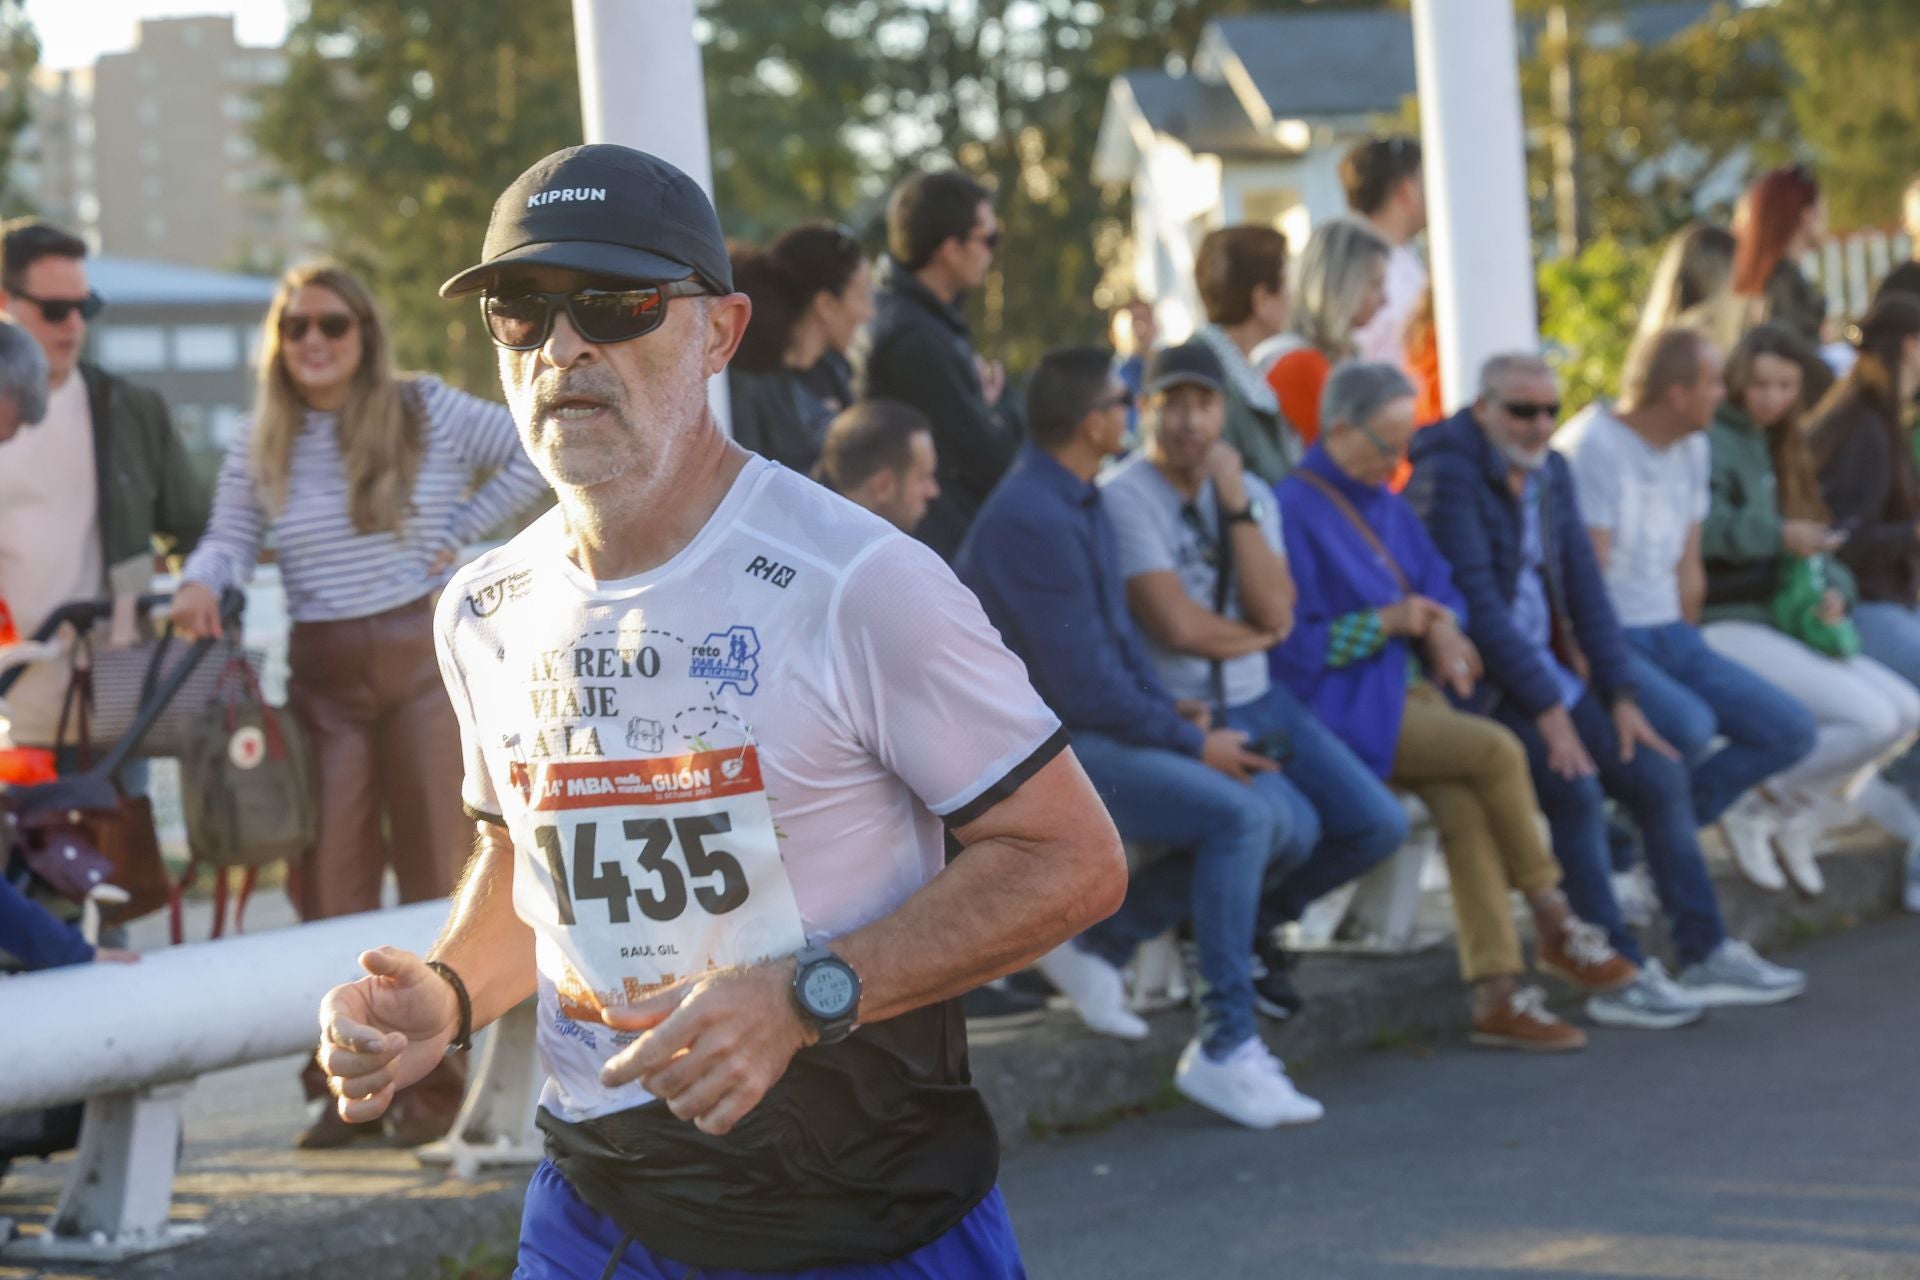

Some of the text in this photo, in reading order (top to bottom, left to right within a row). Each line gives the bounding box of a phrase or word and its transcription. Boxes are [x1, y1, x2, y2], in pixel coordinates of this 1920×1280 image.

[527, 187, 606, 208] KIPRUN
[573, 646, 661, 678] RETO
[692, 646, 720, 657] reto
[529, 686, 619, 718] VIAJE
[531, 725, 606, 758] A LA
[567, 777, 617, 797] MBA
[651, 767, 712, 793] GIJÓN
[535, 811, 750, 926] 1435
[620, 944, 679, 958] RAUL GIL
